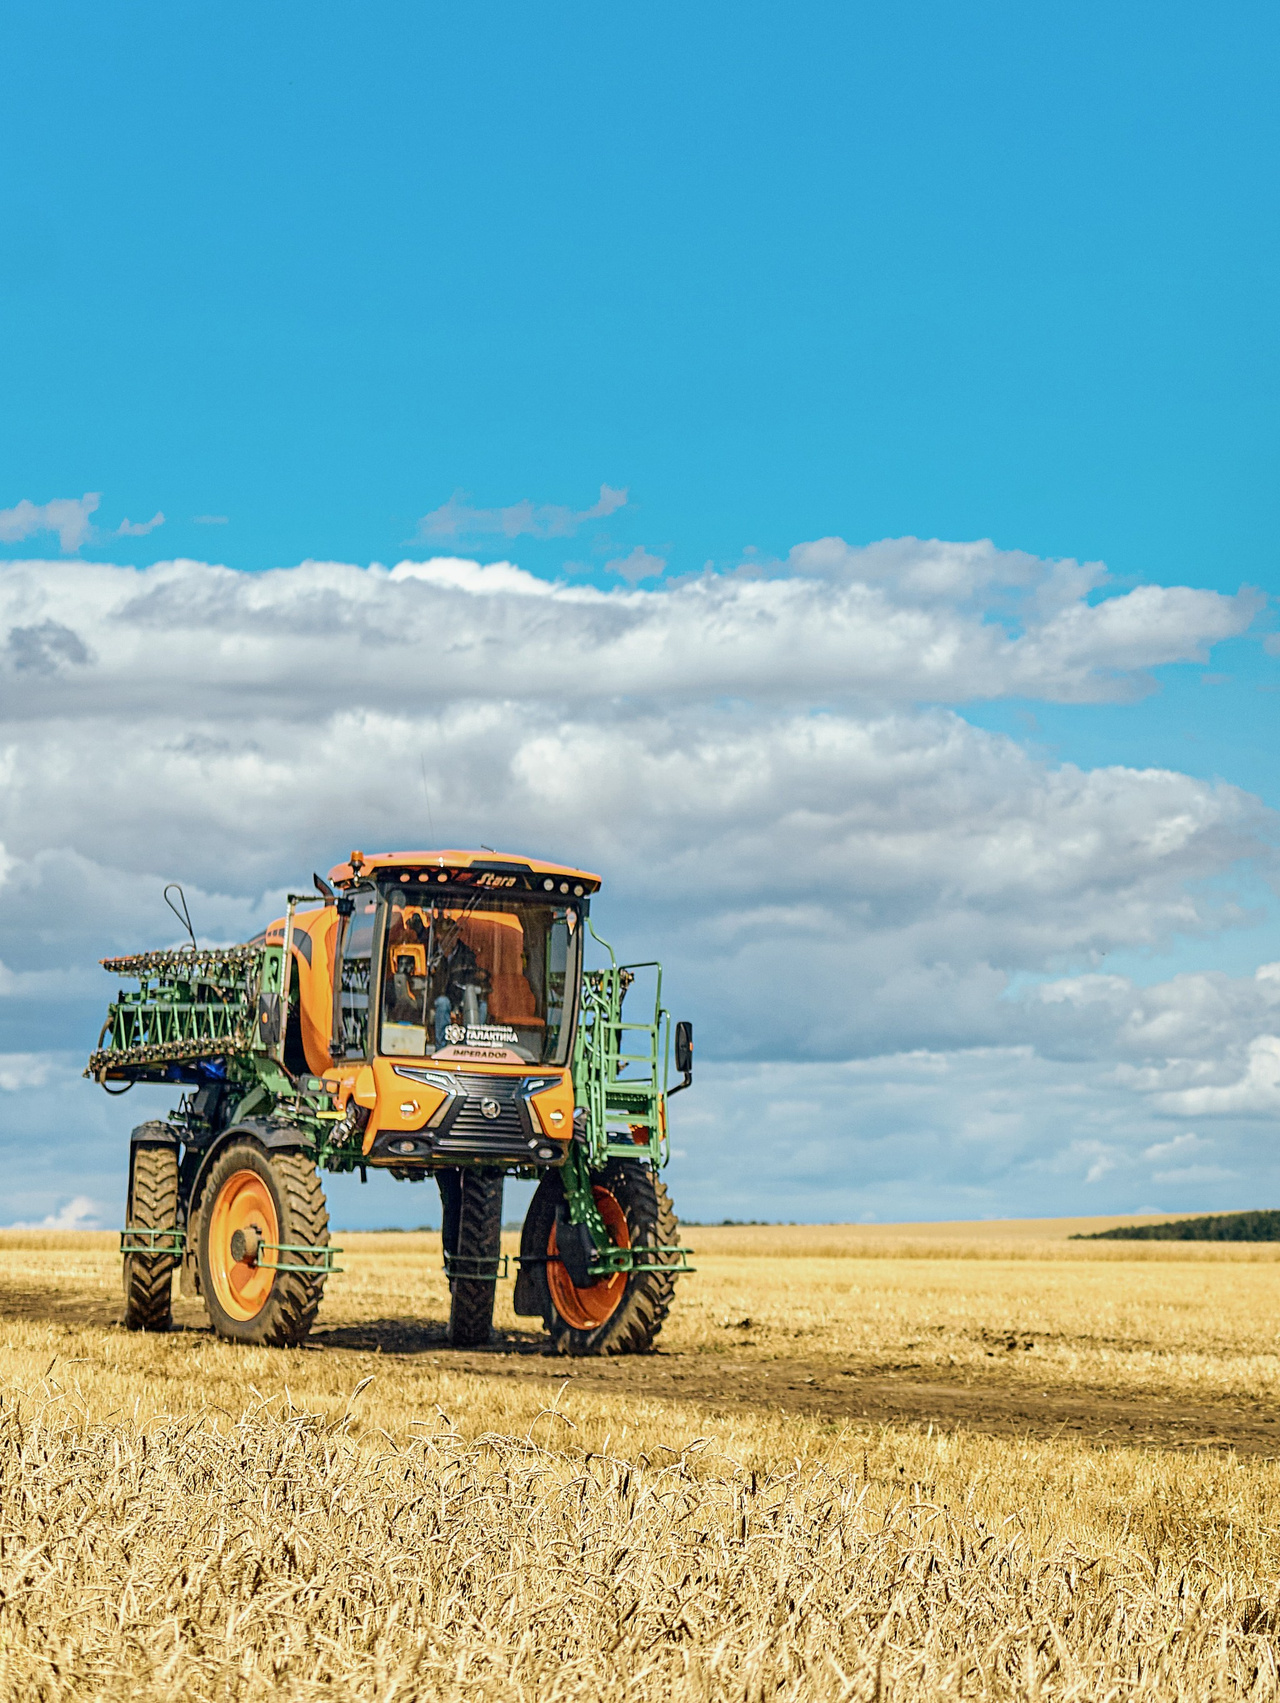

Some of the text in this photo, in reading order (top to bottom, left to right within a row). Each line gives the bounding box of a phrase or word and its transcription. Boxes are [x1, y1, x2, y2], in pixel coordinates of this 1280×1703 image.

[476, 872, 516, 887] Stara
[466, 1030, 518, 1043] ГАЛАКТИКА
[453, 1049, 507, 1059] IMPERADOR
